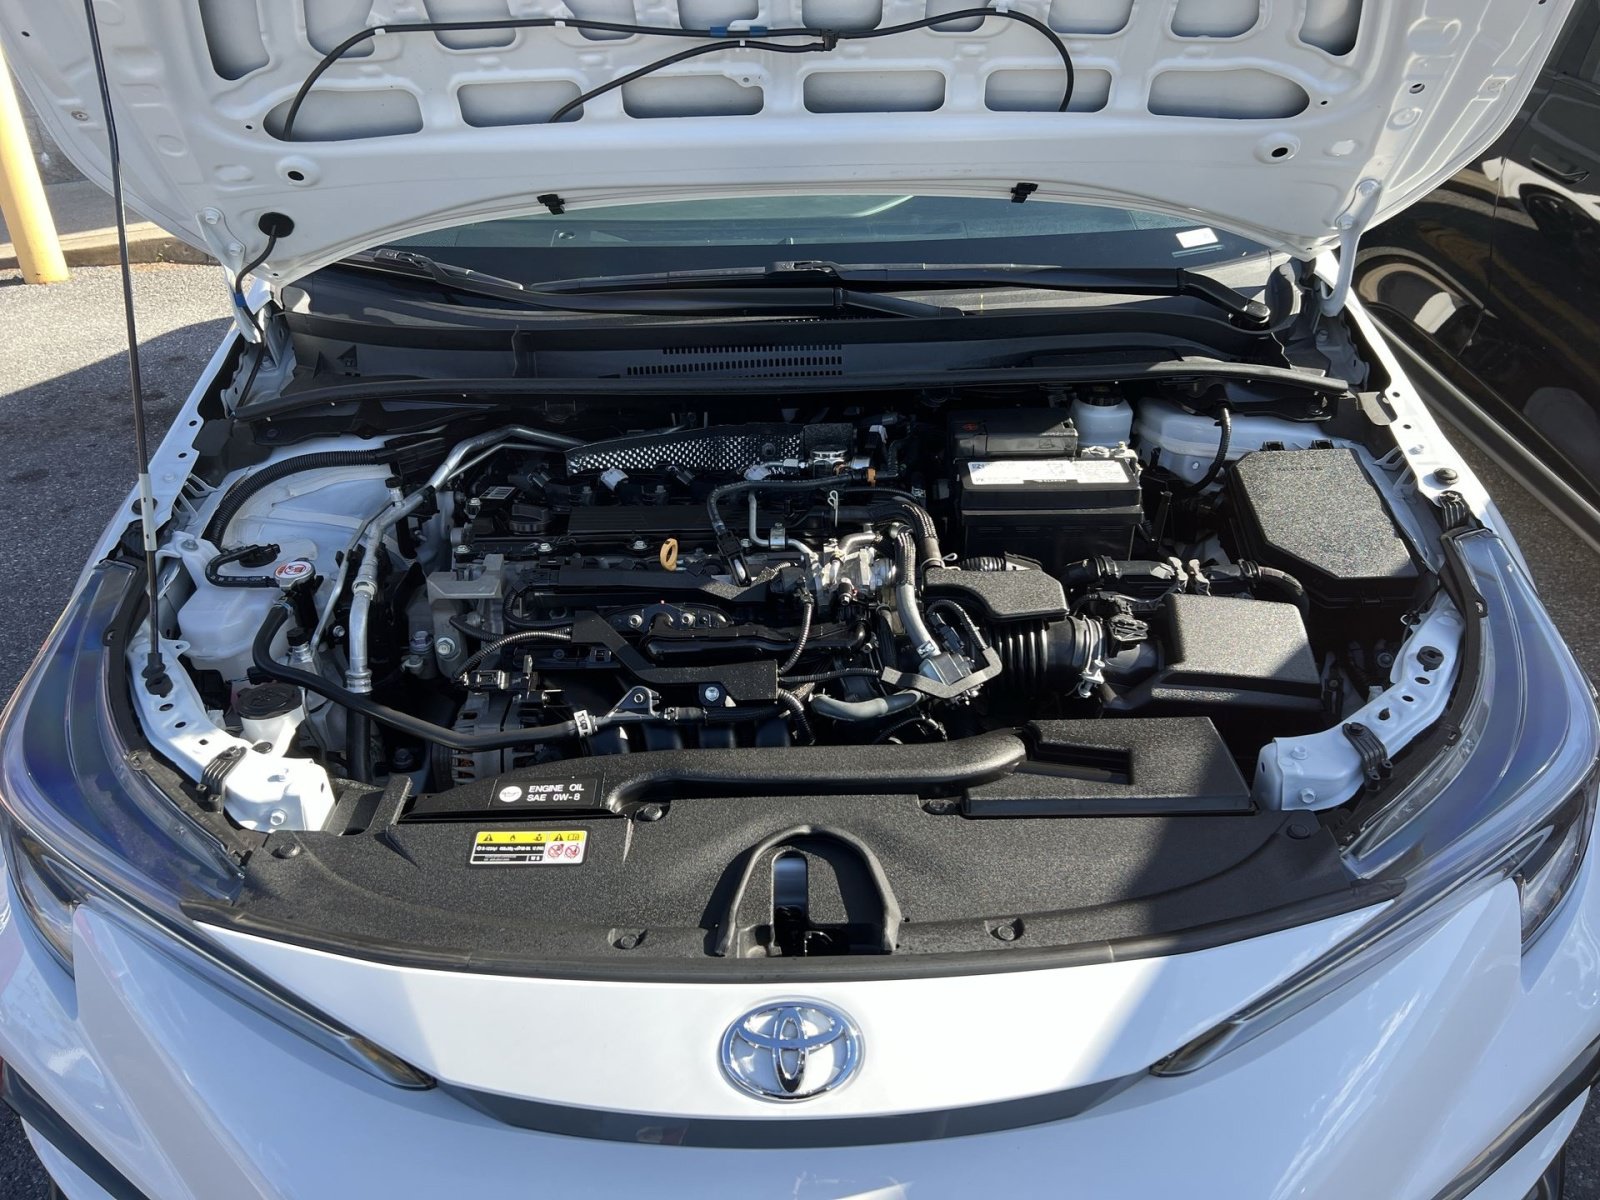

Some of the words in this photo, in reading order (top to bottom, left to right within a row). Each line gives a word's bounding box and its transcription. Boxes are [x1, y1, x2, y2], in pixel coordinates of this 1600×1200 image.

[528, 784, 564, 793] ENGINE
[569, 783, 585, 791] OIL
[526, 793, 547, 802] SAE
